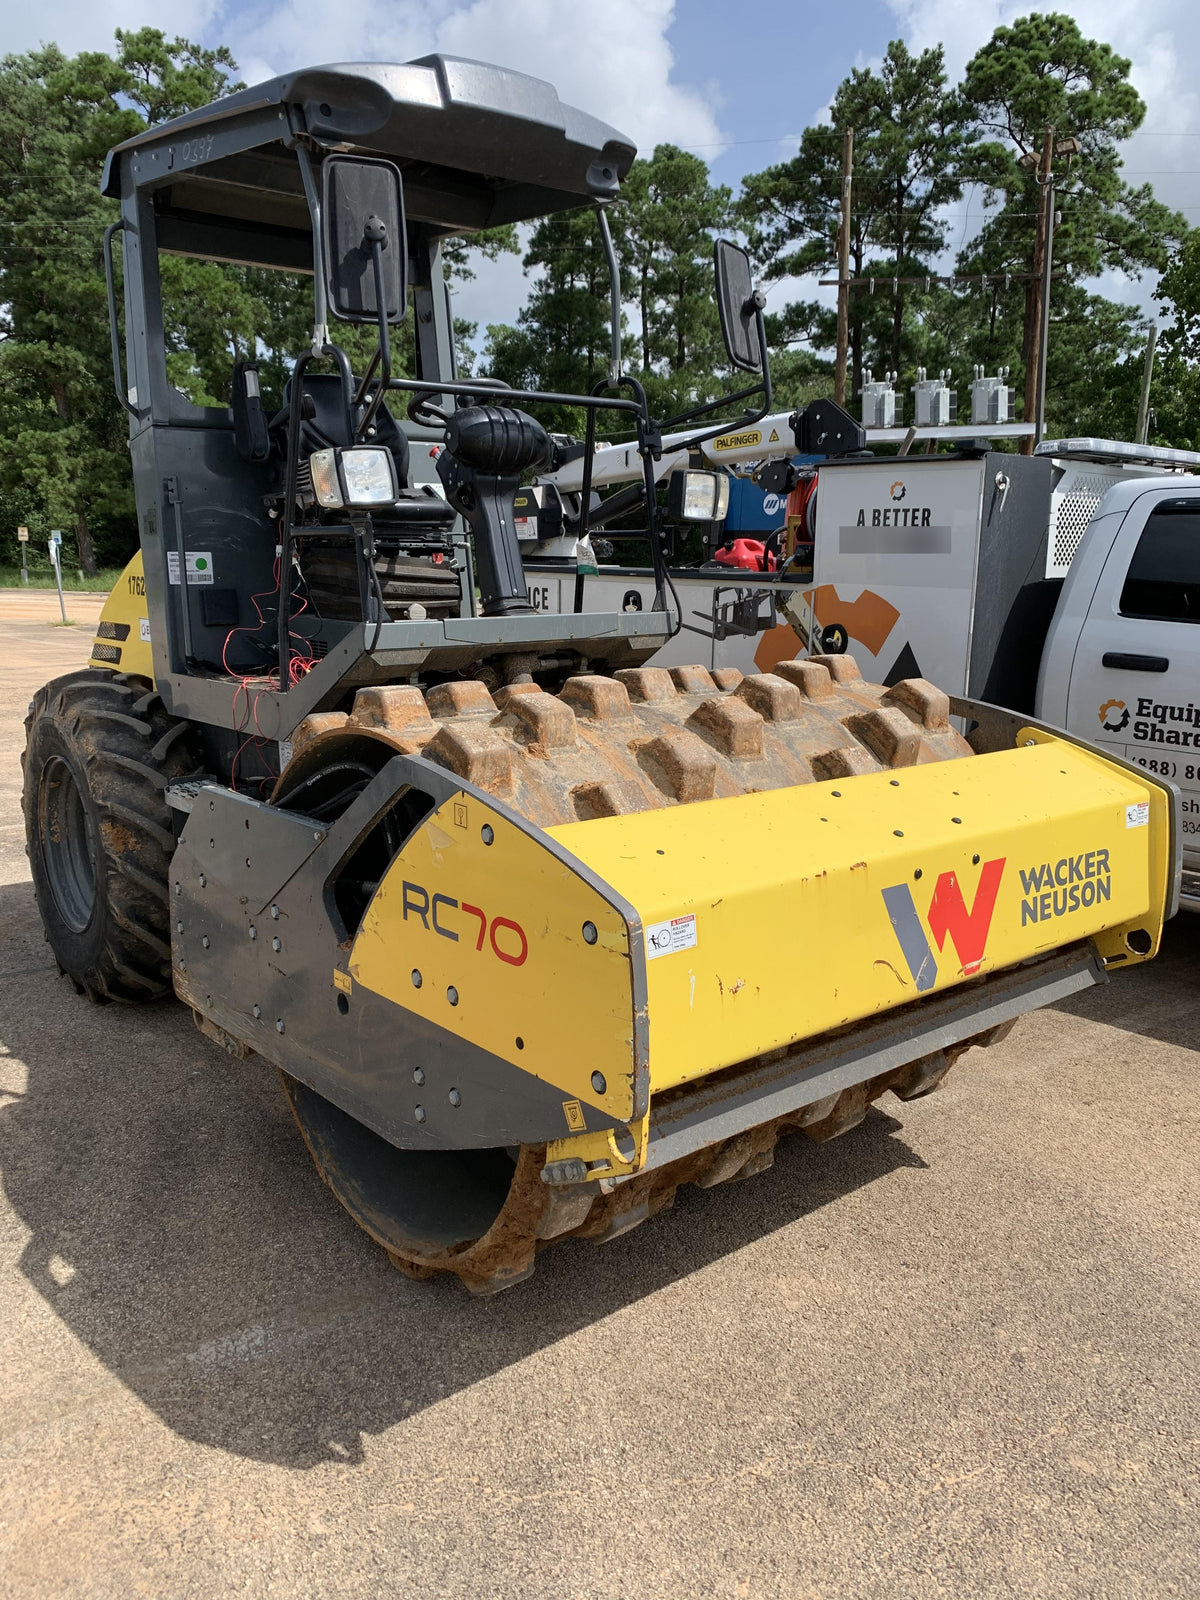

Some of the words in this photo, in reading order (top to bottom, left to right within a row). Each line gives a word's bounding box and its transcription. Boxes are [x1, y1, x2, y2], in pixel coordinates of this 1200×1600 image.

[716, 433, 759, 449] PALFINGER
[857, 508, 866, 527] A
[872, 507, 932, 527] BETTER
[1018, 848, 1111, 896] WACKER
[402, 880, 529, 967] RC70
[1021, 875, 1112, 928] NEUSON
